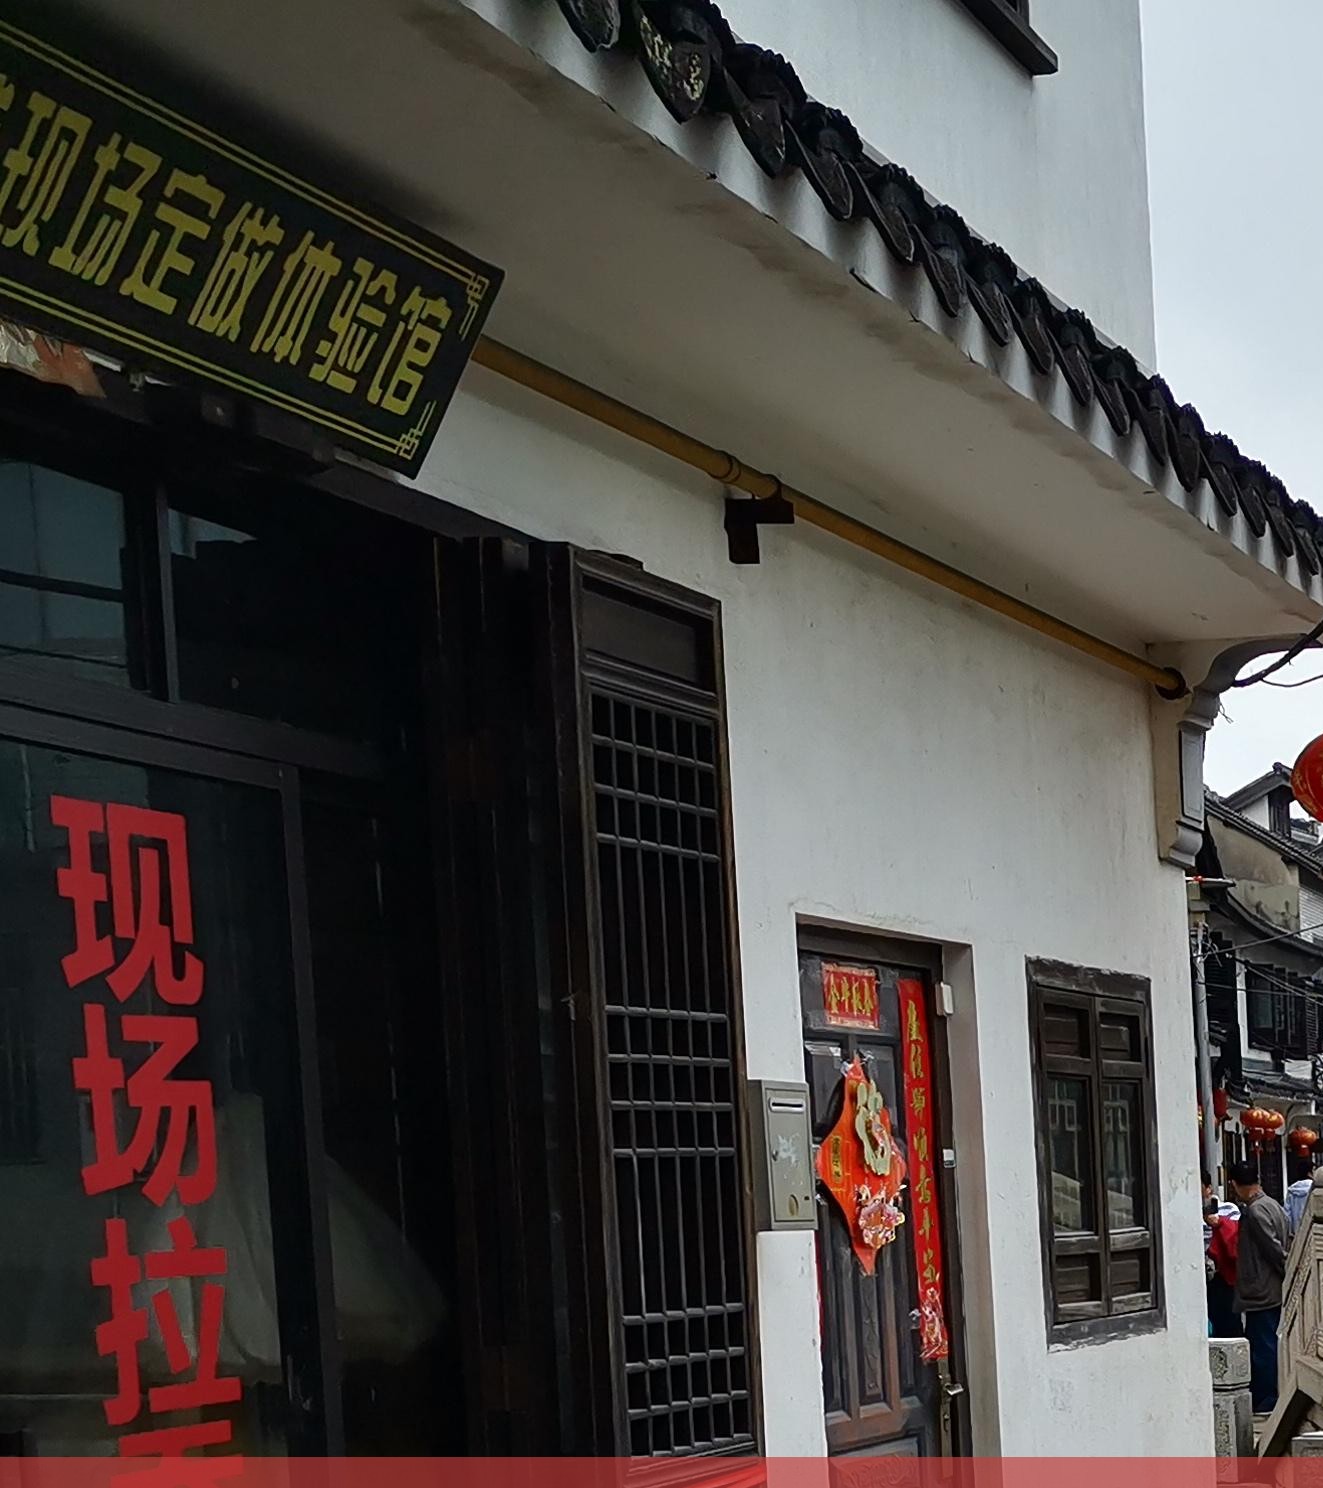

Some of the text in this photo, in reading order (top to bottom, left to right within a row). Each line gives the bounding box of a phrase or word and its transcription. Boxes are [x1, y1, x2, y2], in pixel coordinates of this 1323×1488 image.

[0, 72, 451, 416] 现场定做体验馆
